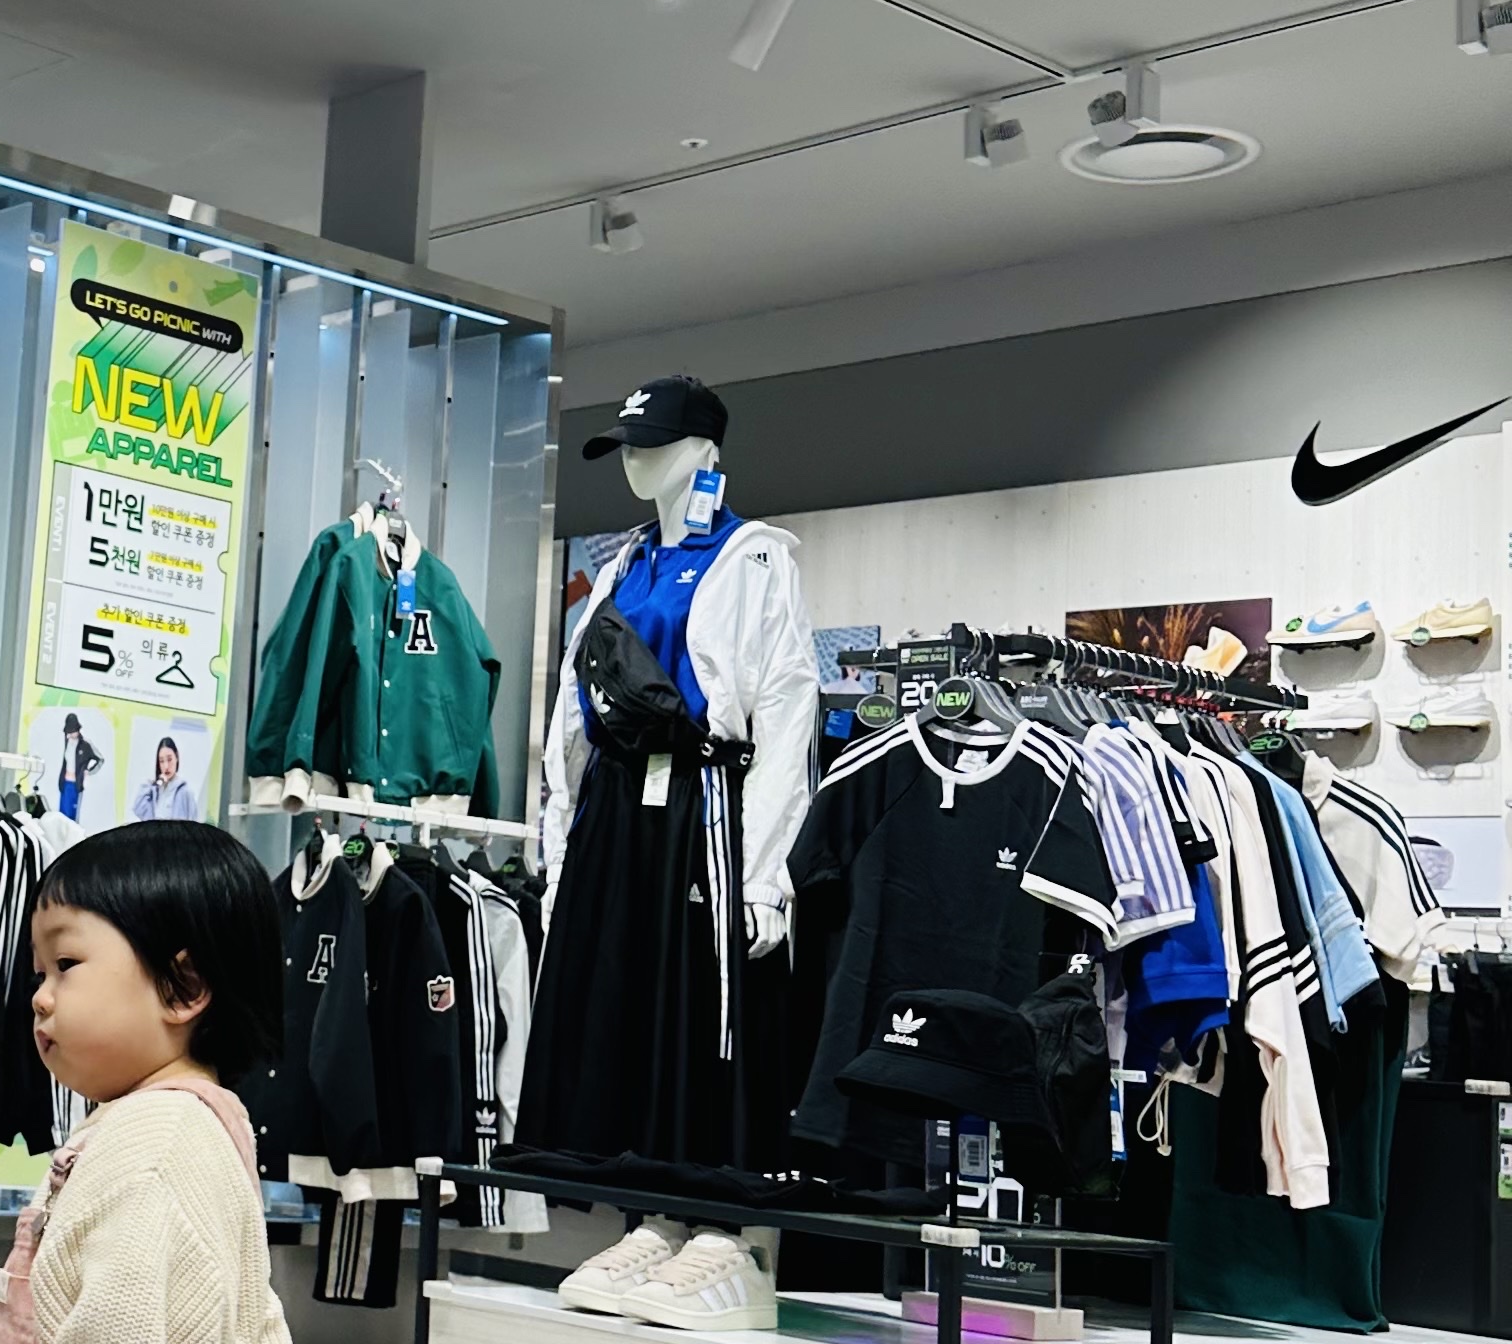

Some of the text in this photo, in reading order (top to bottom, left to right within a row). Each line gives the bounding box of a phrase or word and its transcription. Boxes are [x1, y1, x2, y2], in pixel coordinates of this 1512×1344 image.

[85, 289, 233, 346] LET'S GO PICNIC WITH
[71, 354, 225, 447] NEW
[86, 427, 233, 488] APPAREL
[404, 609, 438, 654] A
[935, 691, 972, 707] NEW
[860, 704, 894, 719] NEW
[1249, 737, 1284, 751] 20
[343, 840, 366, 855] 20
[883, 1032, 920, 1047] adidas
[980, 1244, 1006, 1269] 10
